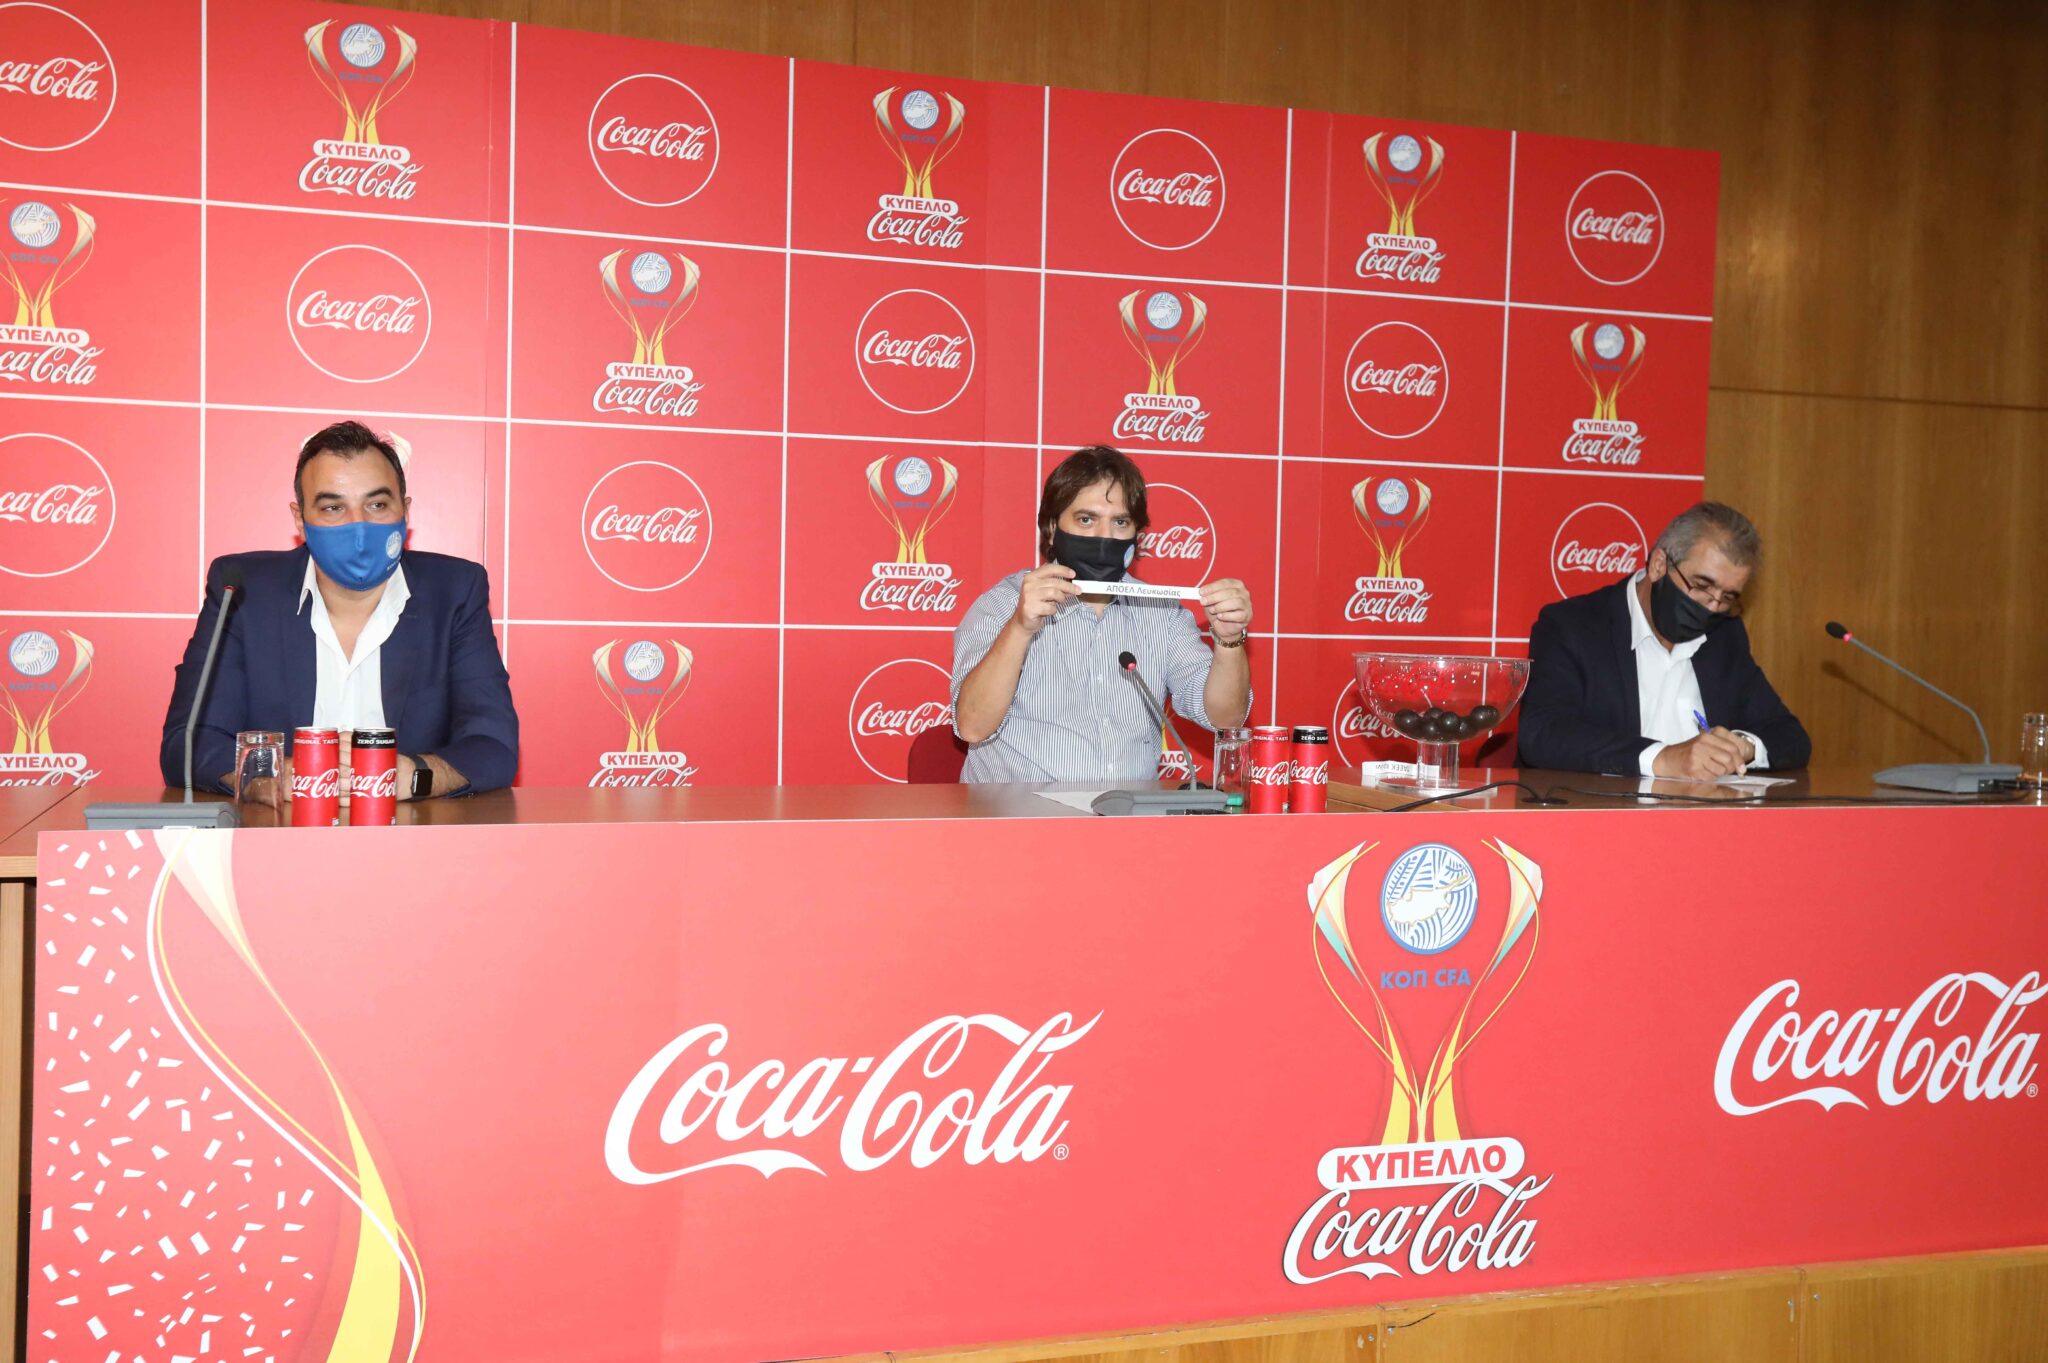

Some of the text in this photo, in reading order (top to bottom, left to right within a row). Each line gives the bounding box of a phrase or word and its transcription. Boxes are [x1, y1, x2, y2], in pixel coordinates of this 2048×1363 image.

[0, 57, 106, 100] ca-Cola
[322, 143, 402, 160] ΚΥΠΕΛΛΟ
[597, 116, 711, 161] Coca-Cola
[298, 156, 424, 200] Coca-Cola
[1118, 168, 1218, 207] Coca-Cola
[885, 197, 951, 213] ΚΥΠΕΛΛΟ
[866, 208, 970, 249] Coca-Cola
[1373, 236, 1431, 251] ΚΥΠΕΛΛΟ
[1572, 208, 1657, 245] Coca-Cola
[1355, 247, 1446, 284] Coca-Cola
[296, 290, 423, 334] Coca-Cola
[0, 344, 105, 385] ca-Cola
[863, 330, 967, 370] Coca-Cola
[613, 365, 687, 381] ΚΥΠΕΛΛΟ
[1351, 360, 1442, 397] Coca-Cola
[592, 378, 706, 417] Coca-Cola
[1131, 396, 1194, 411] ΚΥΠΕΛΛΟ
[1112, 407, 1211, 443] Coca-Cola
[1578, 421, 1632, 434] ΚΥΠΕΛΛΟ
[1562, 432, 1647, 466] Coca-Cola
[0, 484, 105, 524] ca-Cola
[590, 504, 705, 544] Coca-Cola
[1137, 526, 1209, 559] ca-Cola
[878, 565, 945, 577] ΚΥΠΕΛΛΟ
[1557, 540, 1642, 574] Coca-Cola
[859, 575, 963, 613] Coca-Cola
[1106, 585, 1181, 597] ΑΠΟΕΛ Λευκωσίας
[1361, 579, 1418, 591] ΚΥΠΕΛΛΟ
[1344, 589, 1434, 624] Coca-Cola
[0, 756, 78, 768] ΥΠΕΛΛΟ
[607, 755, 679, 766] ΚΥΠΕΛΛΟ
[1381, 968, 1472, 989] ΚΟΠ CFA
[1714, 971, 2048, 1116] Coca-Cola
[604, 1008, 1104, 1185] Coca-Cola
[1336, 1145, 1507, 1183] ΚΥΠΕΛΛΟ
[1282, 1173, 1554, 1285] Coca-Cola
